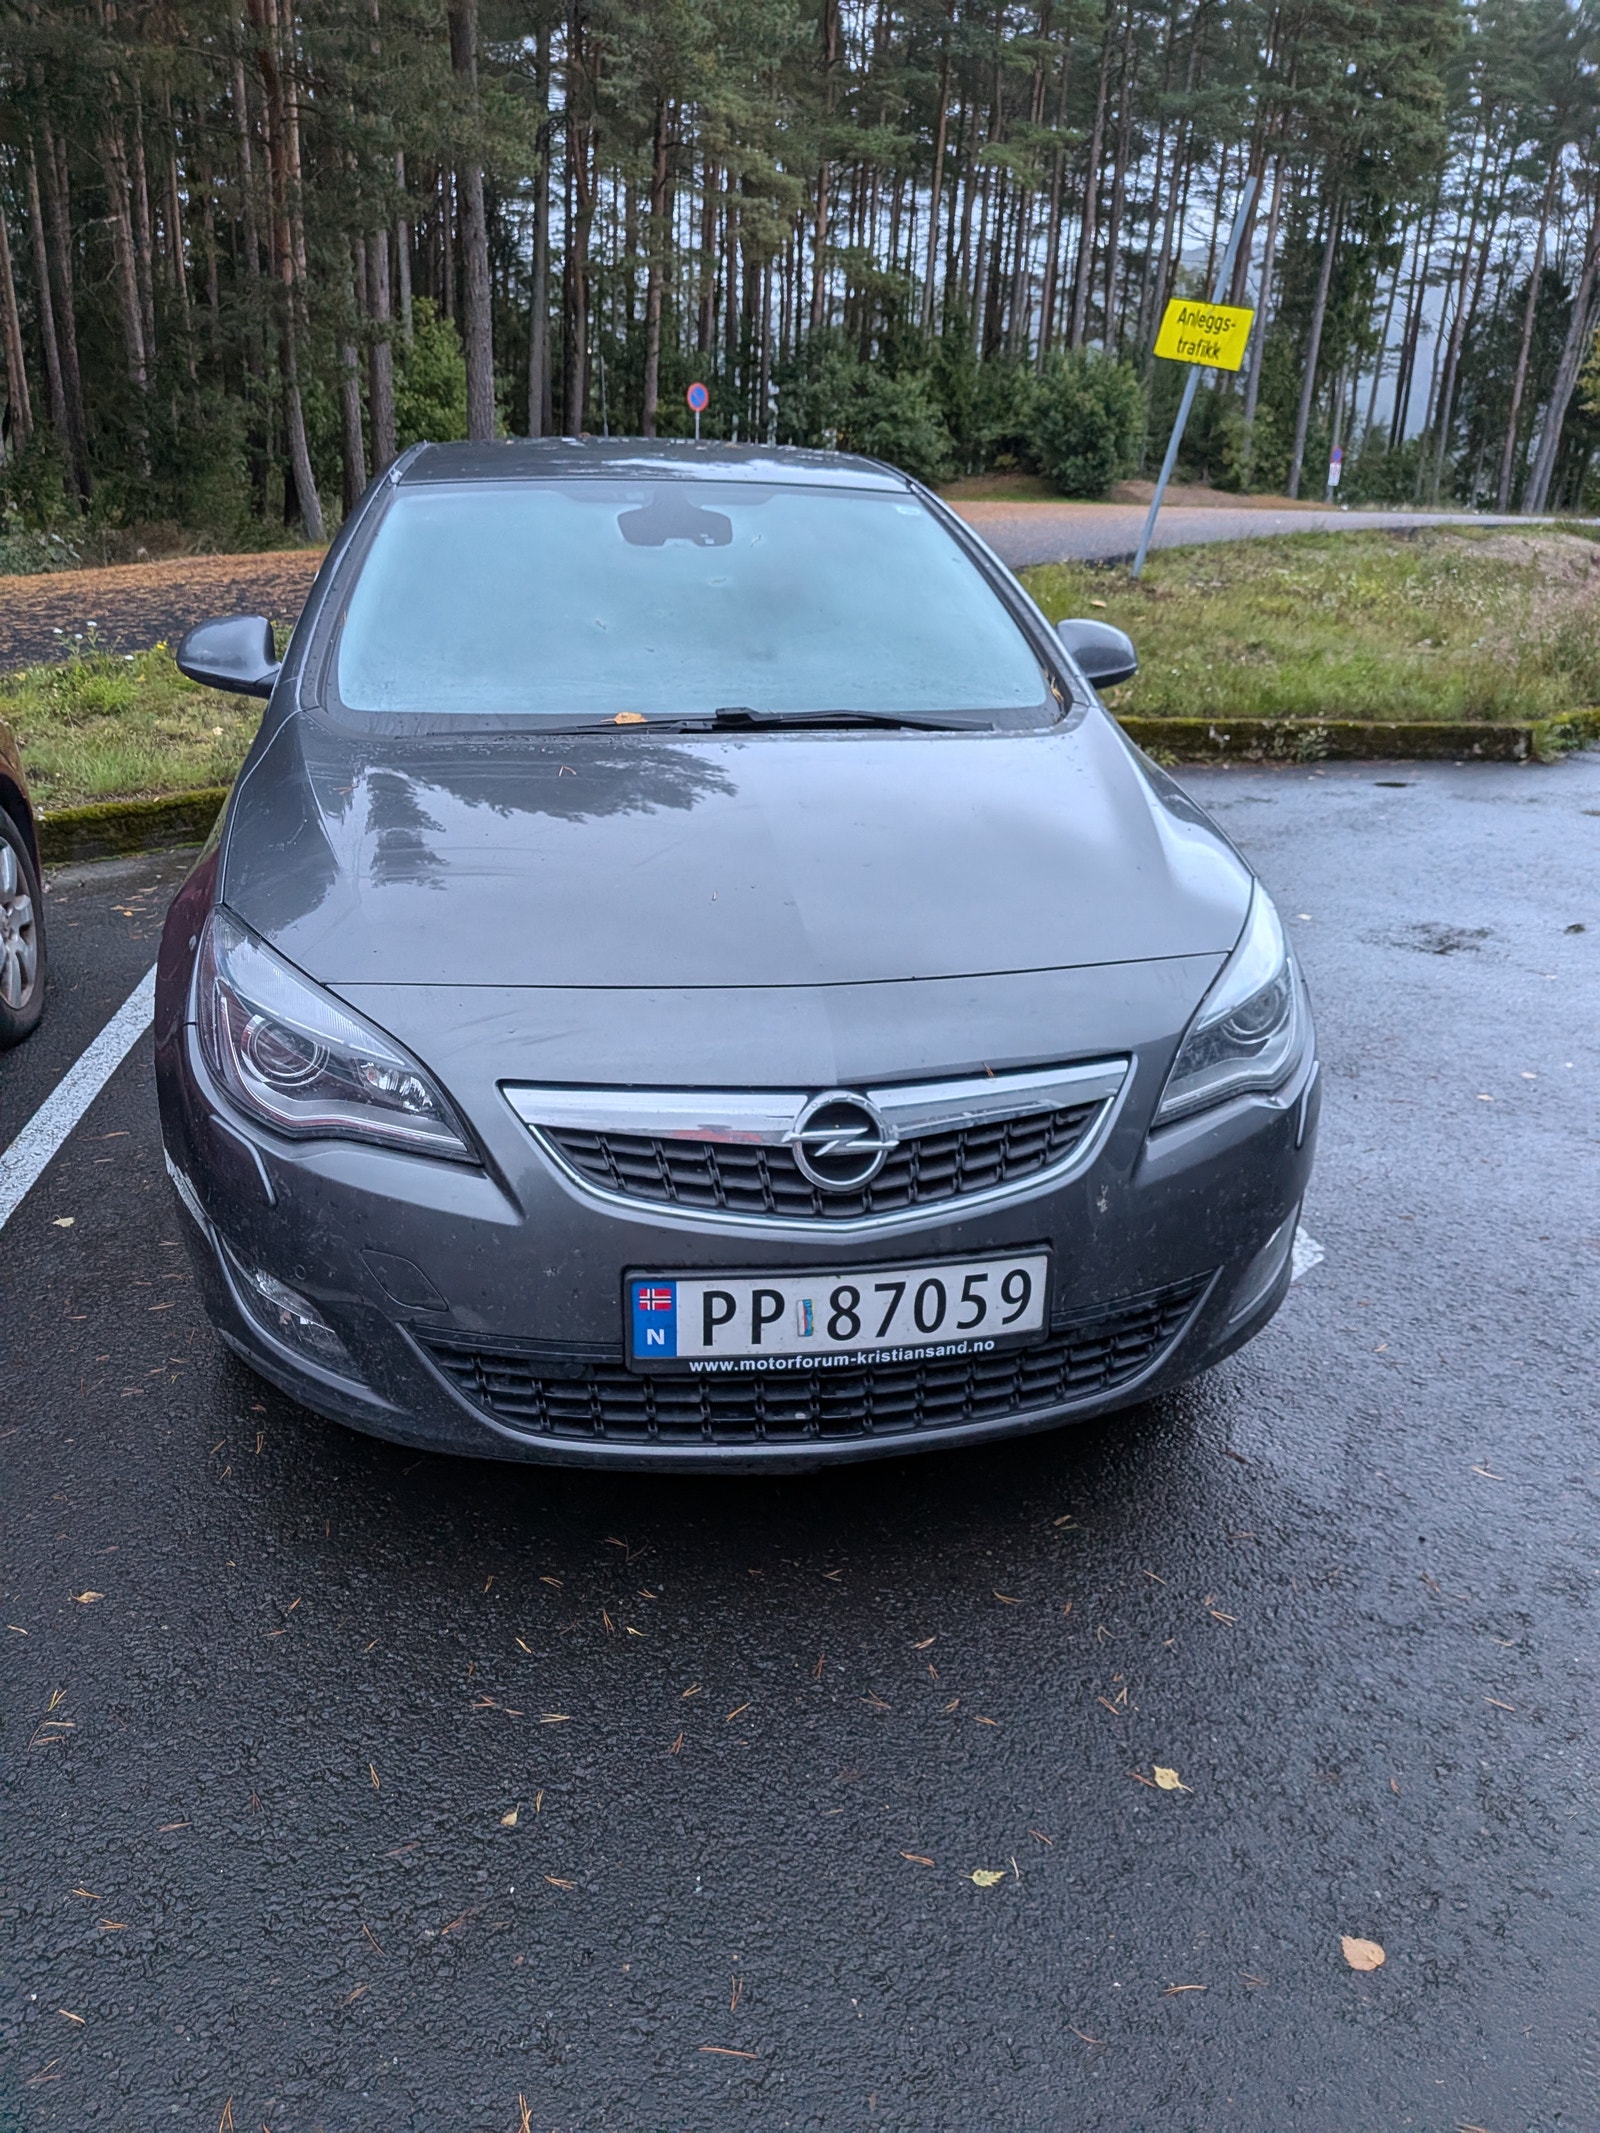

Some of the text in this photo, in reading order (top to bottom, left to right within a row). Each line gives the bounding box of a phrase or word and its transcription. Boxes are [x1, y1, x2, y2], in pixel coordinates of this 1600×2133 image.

[1176, 307, 1236, 335] Anleggs-
[1176, 337, 1221, 360] trafikk
[702, 1268, 1032, 1346] PP 87059
[646, 1328, 665, 1345] N
[688, 1340, 995, 1372] www.motorforum-kristiansand.no
